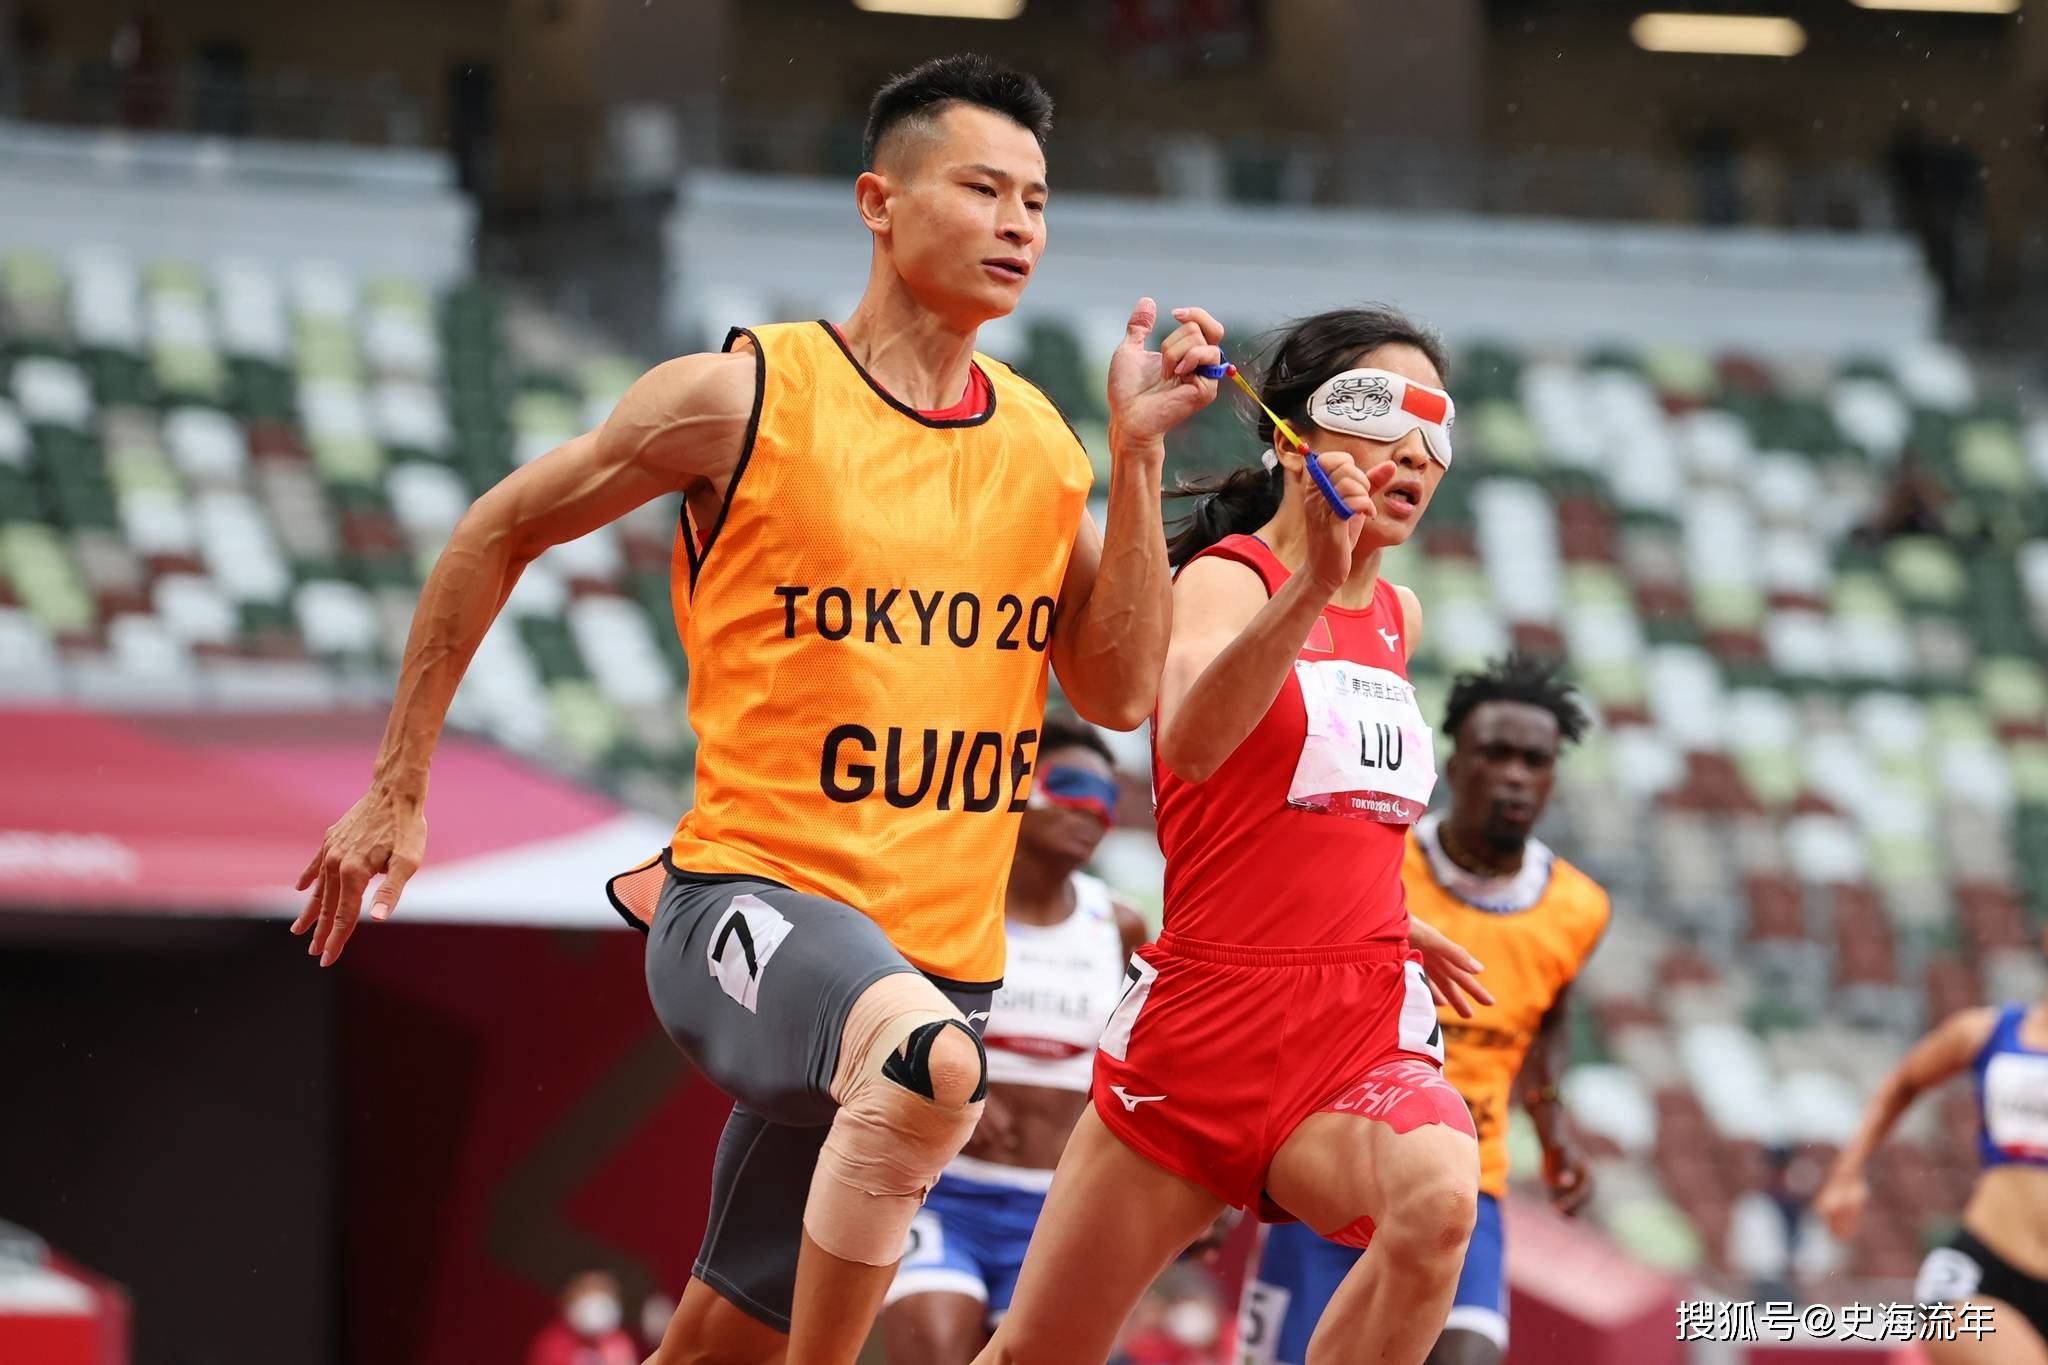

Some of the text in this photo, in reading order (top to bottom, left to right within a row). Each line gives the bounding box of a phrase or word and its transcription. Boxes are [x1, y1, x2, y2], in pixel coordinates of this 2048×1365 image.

[774, 586, 981, 649] TOKYO
[820, 724, 1037, 813] GUIDE
[1358, 720, 1403, 771] LIU
[711, 910, 758, 983] 7
[1333, 1081, 1414, 1117] CHN
